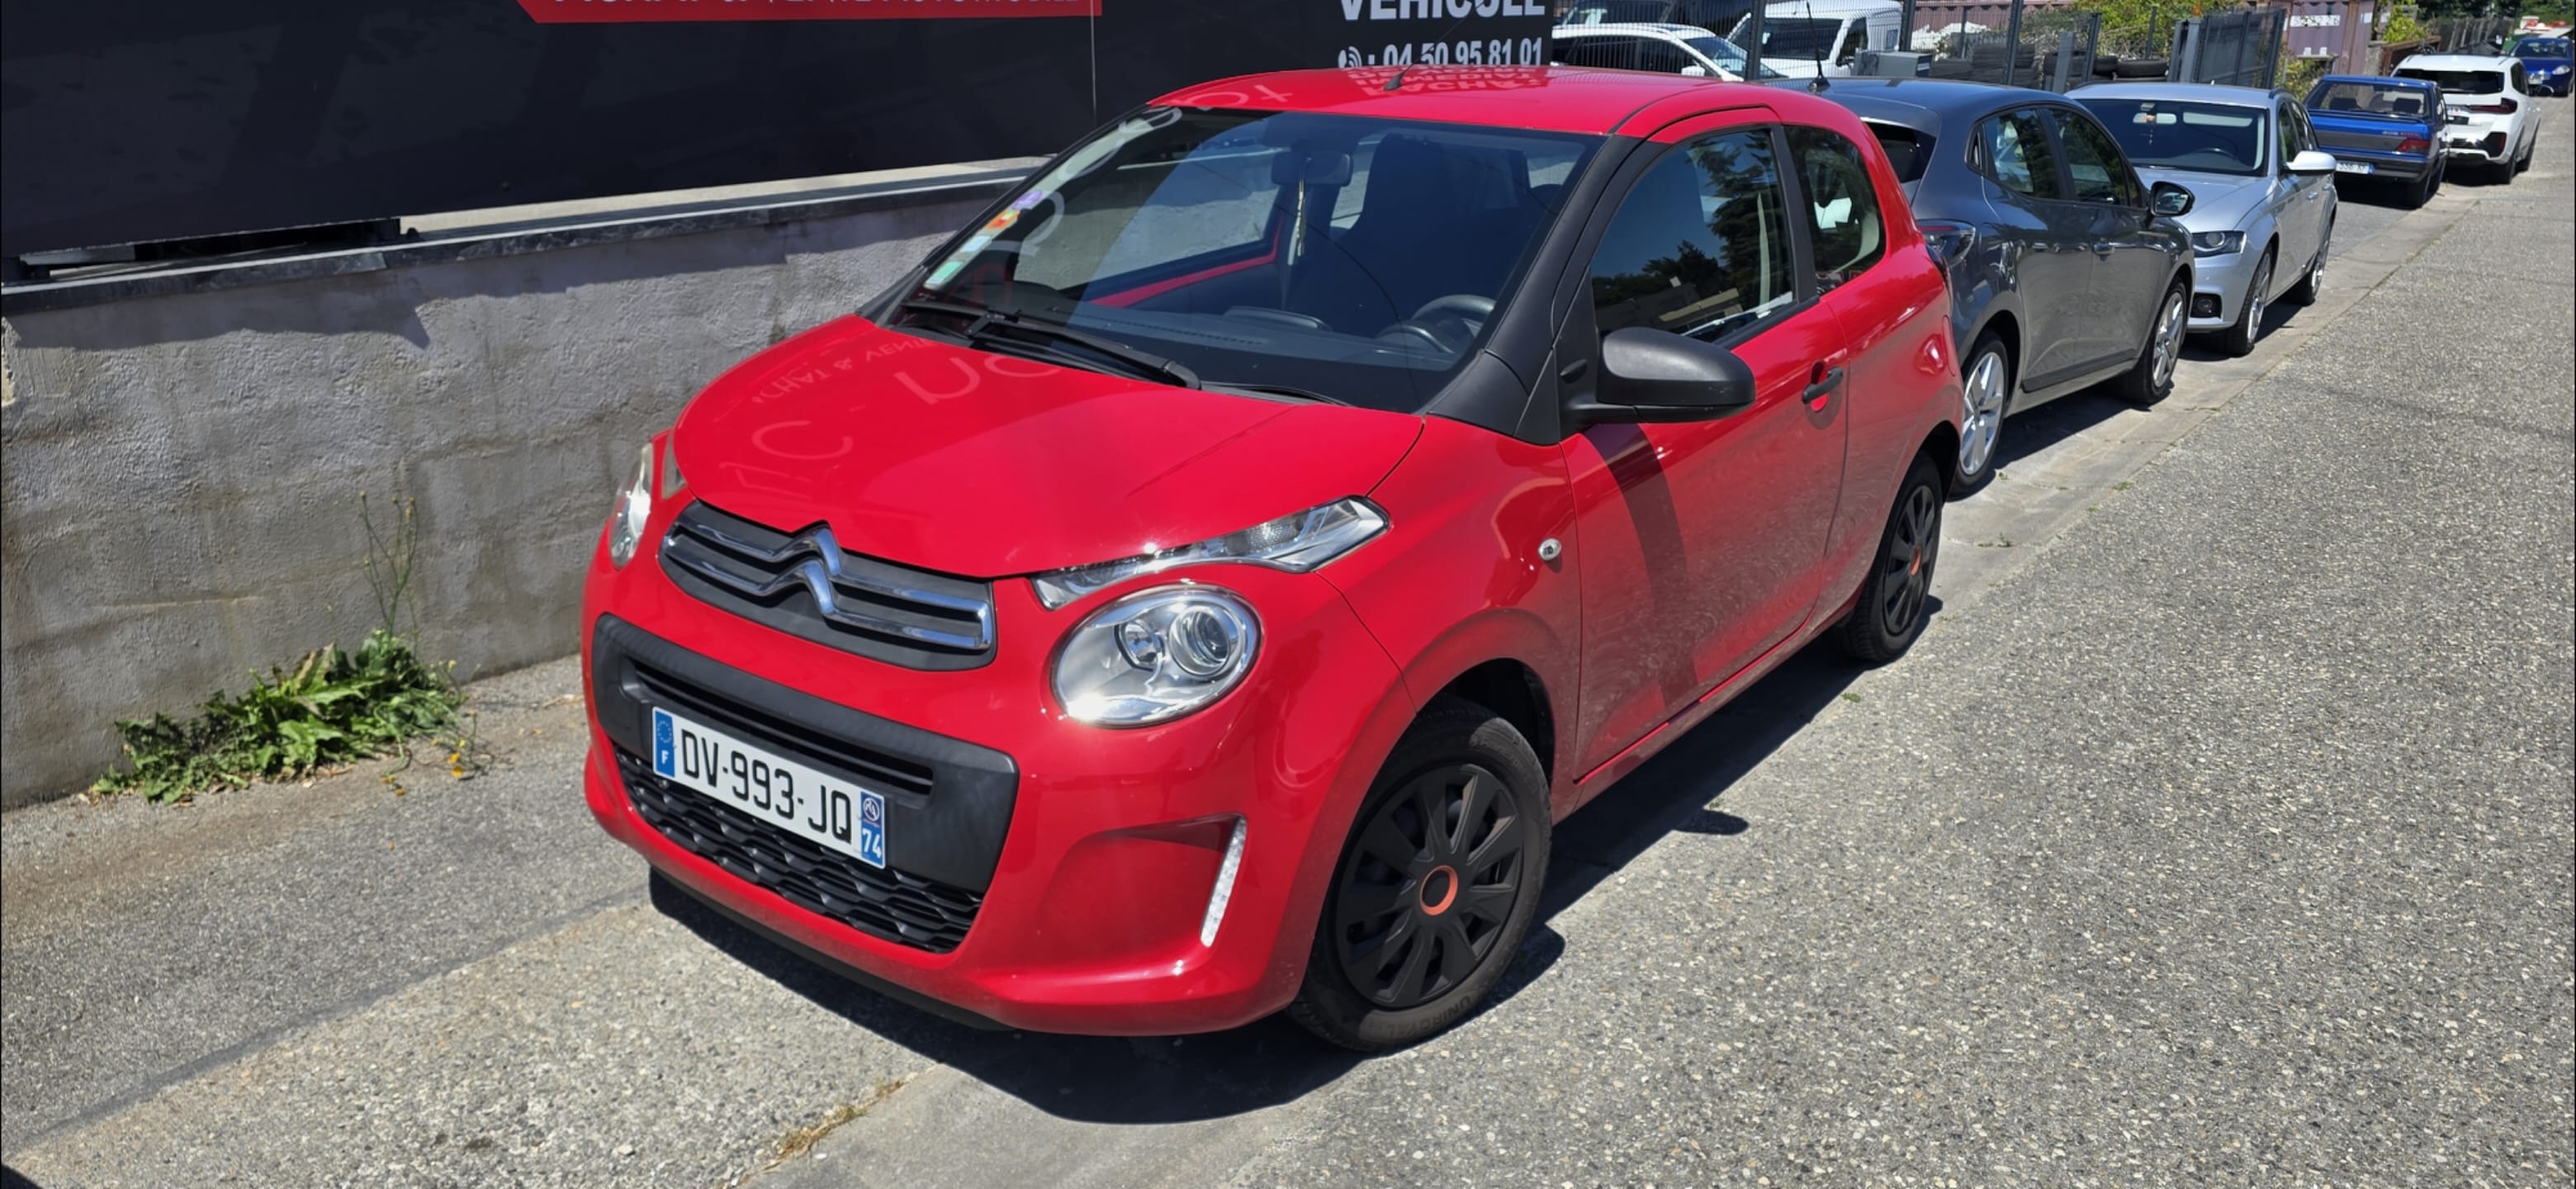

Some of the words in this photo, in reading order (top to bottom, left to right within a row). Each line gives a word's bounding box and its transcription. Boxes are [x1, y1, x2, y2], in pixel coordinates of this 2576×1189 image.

[1383, 43, 1413, 65] 04
[1455, 40, 1482, 65] 95
[1488, 38, 1513, 65] 81
[1519, 36, 1542, 65] 01
[661, 749, 670, 765] F
[681, 729, 852, 845] DV-993-JQ
[862, 827, 883, 859] 74
